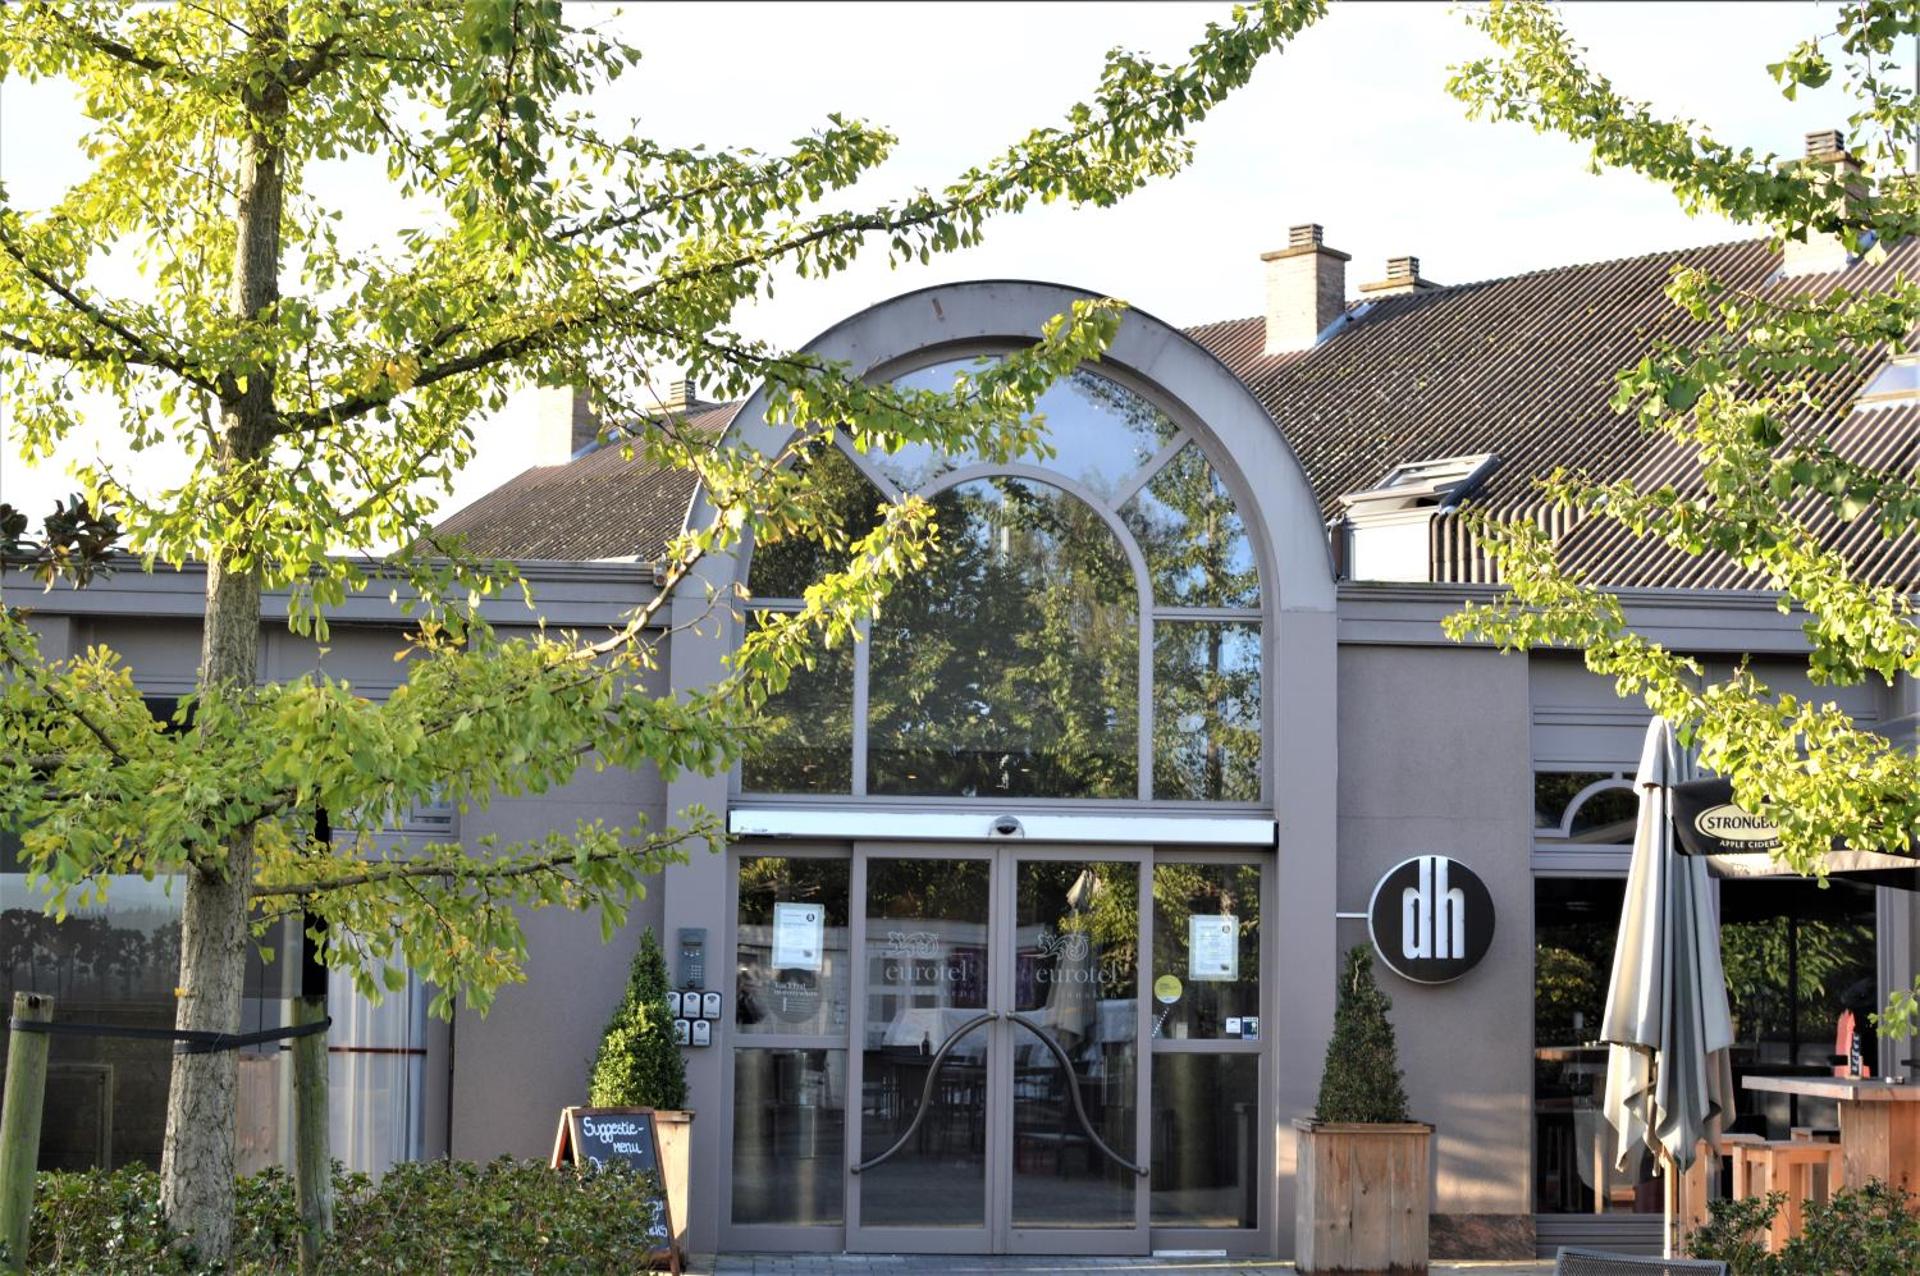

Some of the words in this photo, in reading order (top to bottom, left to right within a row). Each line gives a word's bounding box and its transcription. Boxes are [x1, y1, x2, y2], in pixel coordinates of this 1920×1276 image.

[1707, 816, 1779, 829] STRONGBO
[1720, 840, 1745, 848] APPLE
[1402, 855, 1465, 960] dh
[885, 959, 967, 981] eurotel
[1035, 959, 1117, 984] eurotel
